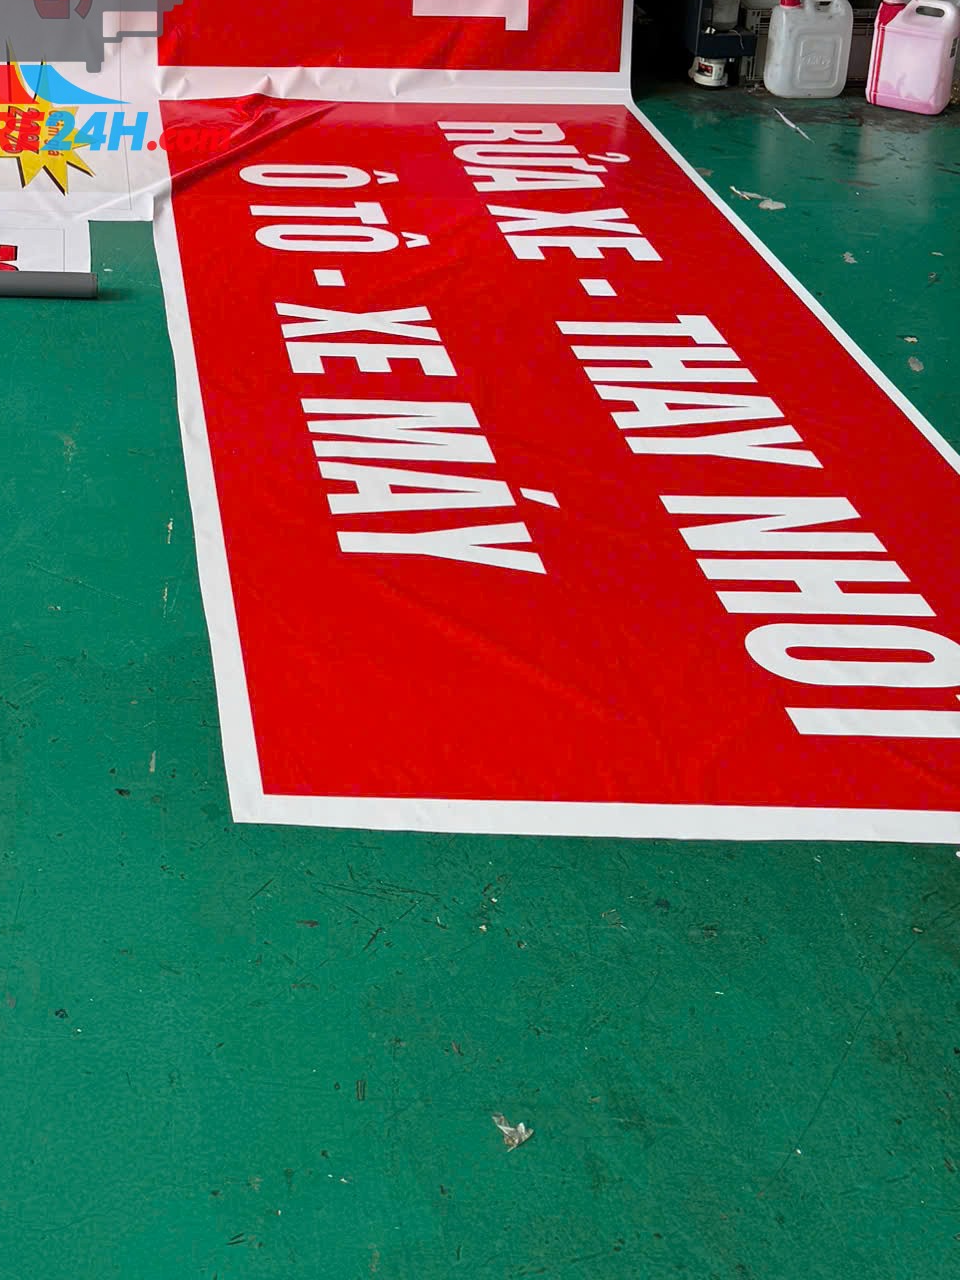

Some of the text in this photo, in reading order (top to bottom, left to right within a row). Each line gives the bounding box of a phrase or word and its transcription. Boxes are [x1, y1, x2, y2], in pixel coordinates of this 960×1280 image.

[436, 120, 631, 192] RỬA
[485, 205, 663, 261] XE
[274, 302, 458, 377] XE
[555, 314, 825, 469] THAY
[301, 397, 561, 575] MÁY
